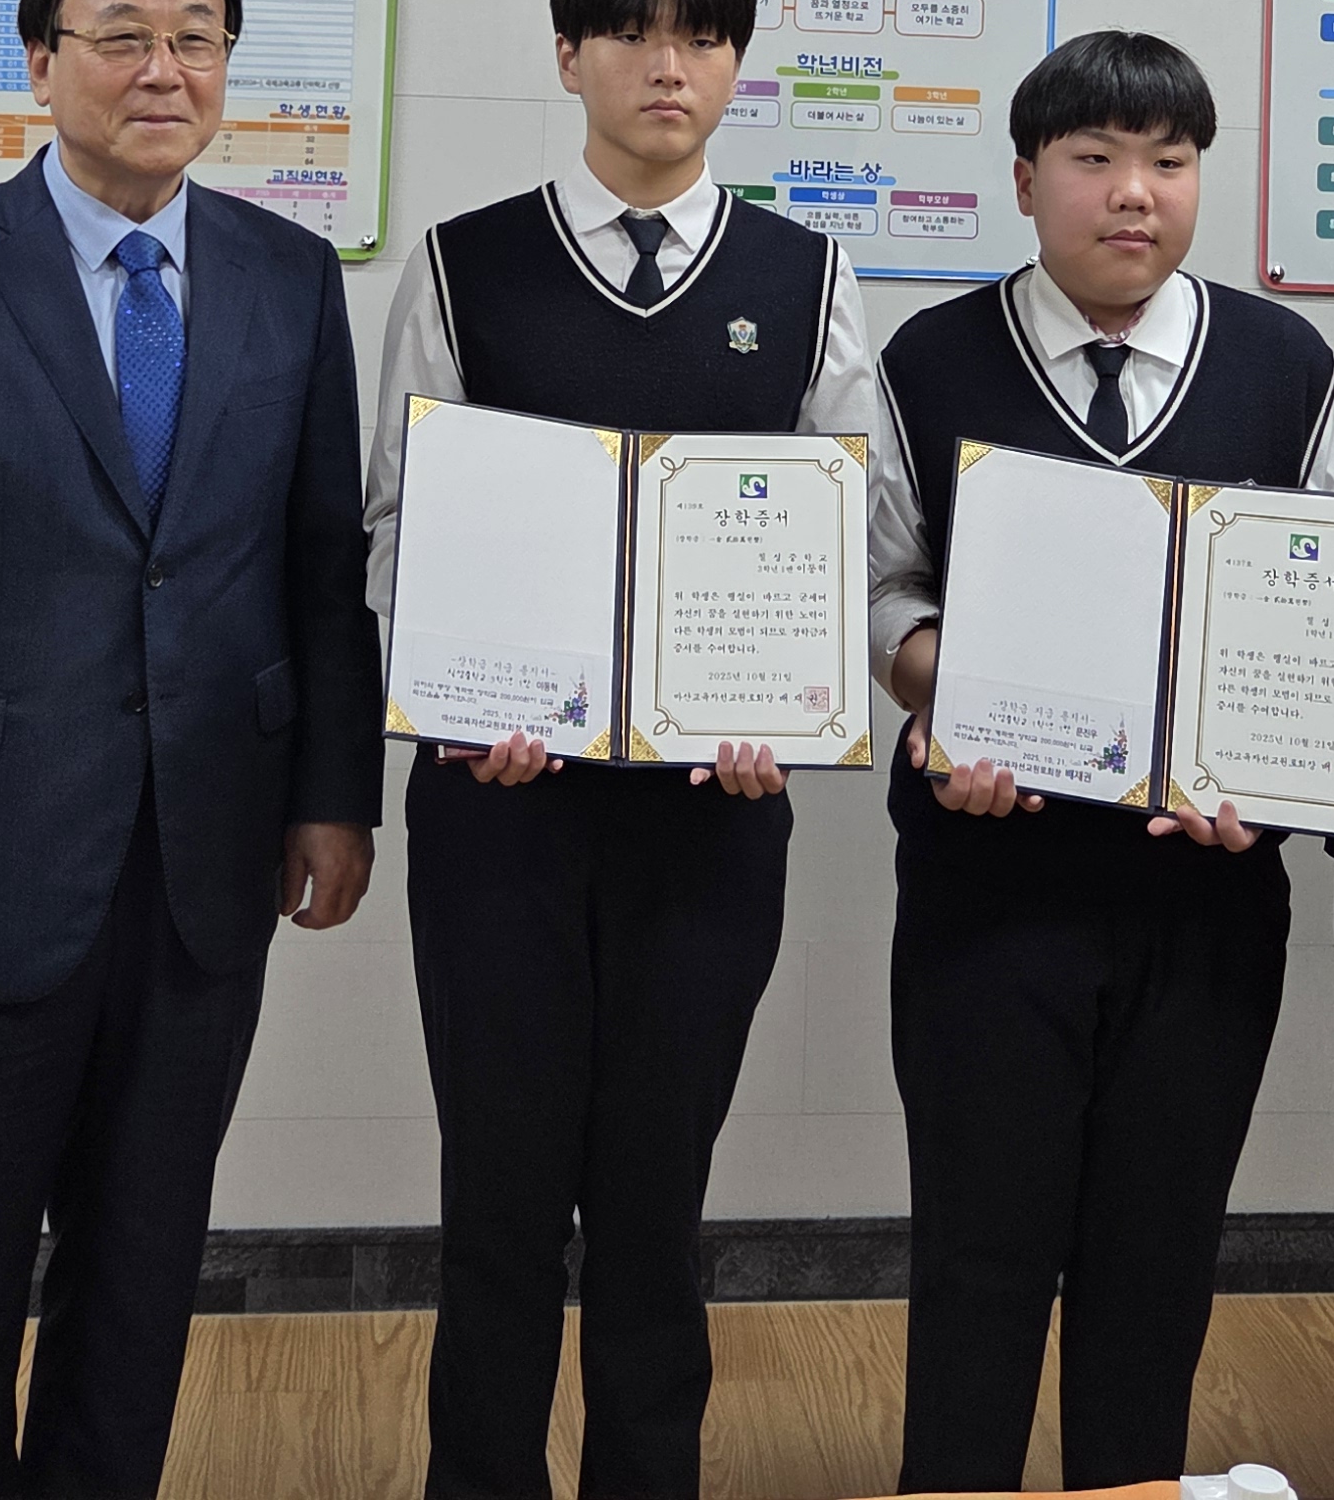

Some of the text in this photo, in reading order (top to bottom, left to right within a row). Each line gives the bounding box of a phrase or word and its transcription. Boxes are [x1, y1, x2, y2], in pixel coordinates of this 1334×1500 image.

[946, 16, 964, 26] 학교
[797, 53, 883, 77] 학년비전
[826, 86, 848, 97] 2학년
[926, 90, 947, 100] 3학년
[790, 160, 882, 184] 바라는 상
[714, 509, 788, 527] 장학증서
